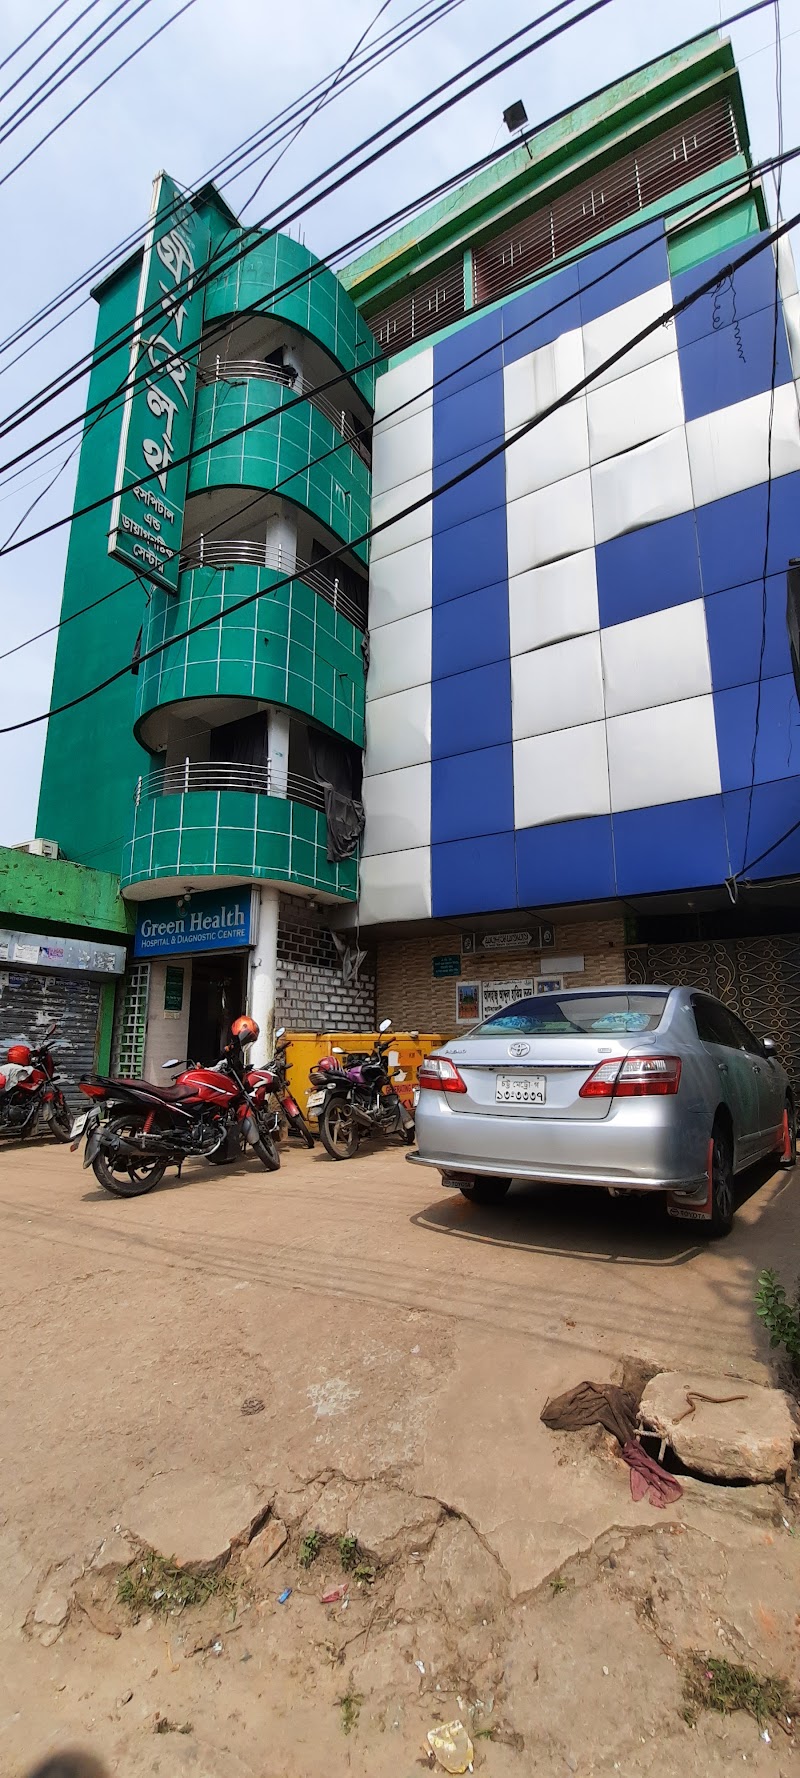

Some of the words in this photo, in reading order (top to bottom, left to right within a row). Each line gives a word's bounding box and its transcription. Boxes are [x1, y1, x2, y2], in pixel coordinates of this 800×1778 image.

[141, 919, 185, 938] Green
[189, 904, 245, 932] Health
[171, 936, 176, 945] &
[497, 1091, 543, 1102] ১৩-৩৩৩৭
[451, 1180, 471, 1188] TOYOTA
[680, 1210, 706, 1220] TOYOTA
